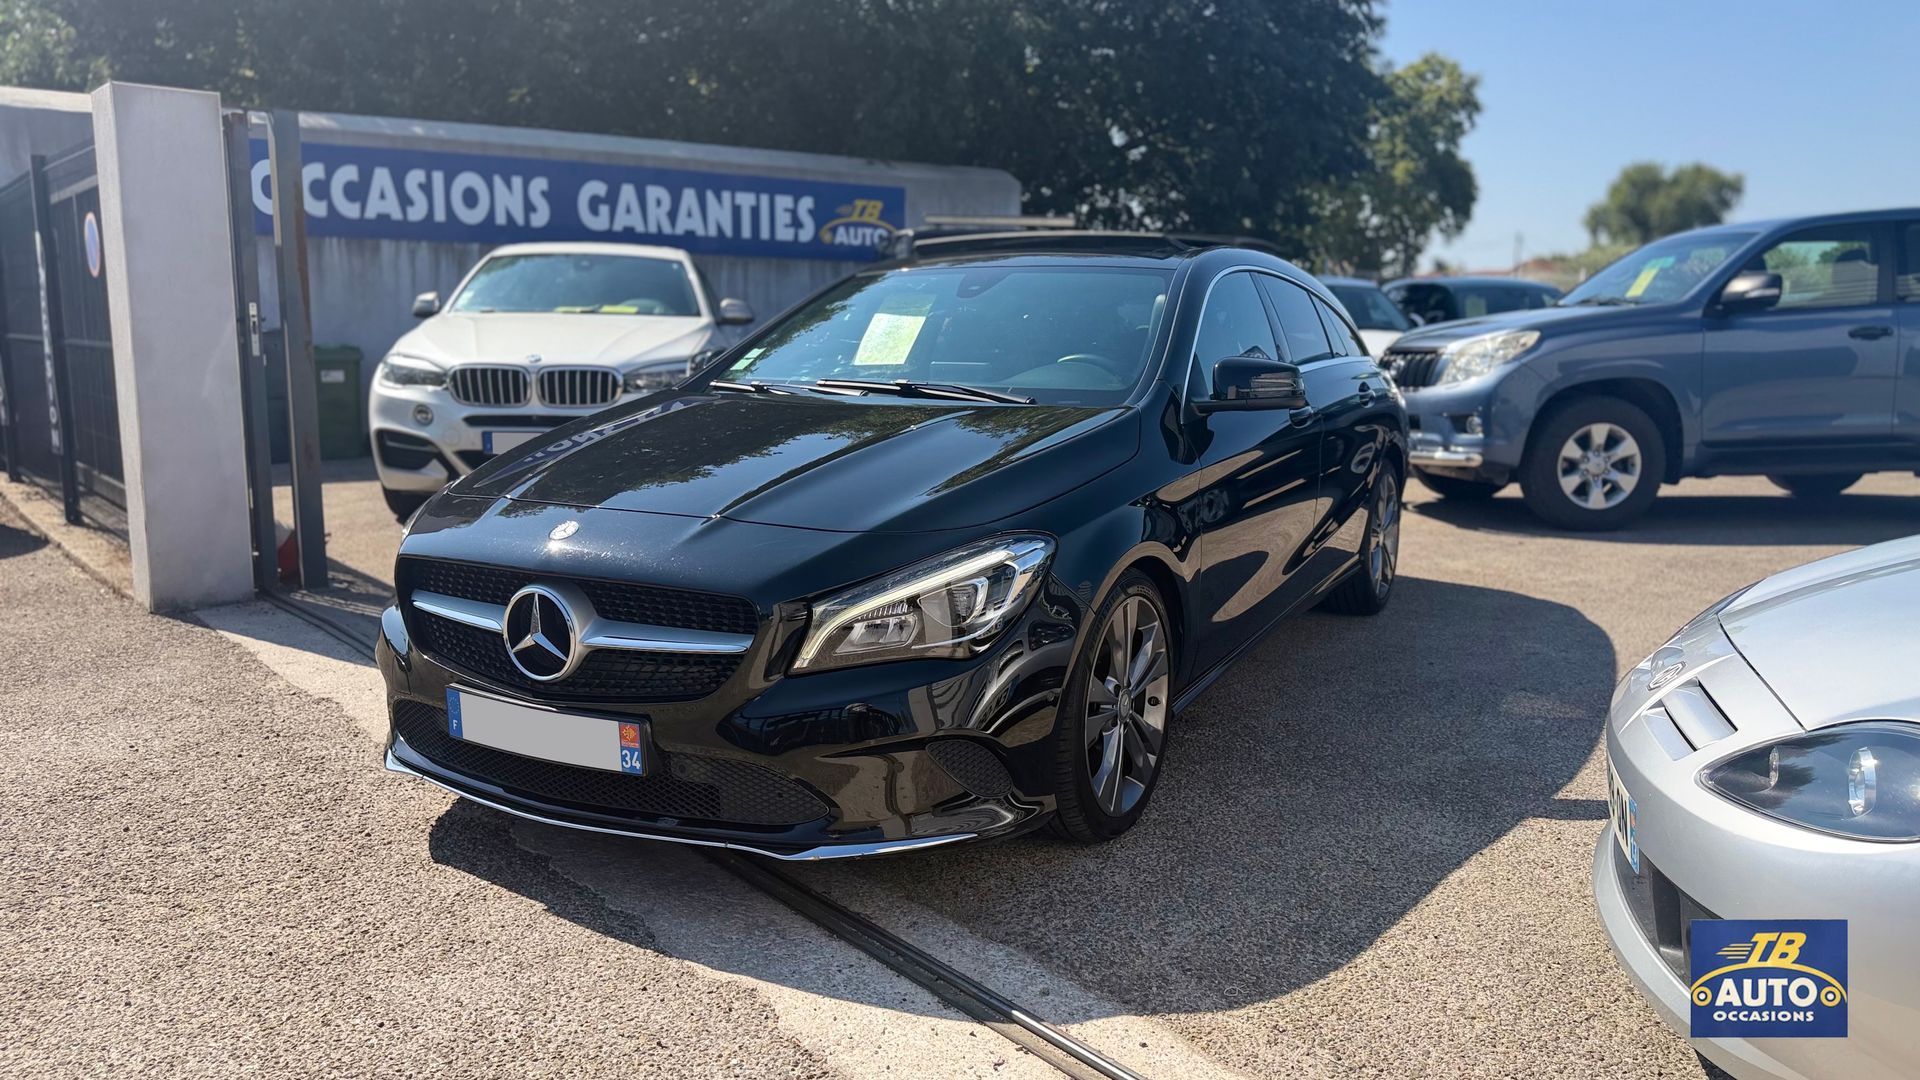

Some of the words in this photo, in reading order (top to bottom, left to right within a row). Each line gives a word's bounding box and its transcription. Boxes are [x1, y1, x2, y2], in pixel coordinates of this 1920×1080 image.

[251, 159, 550, 228] OCCASIONS
[577, 180, 816, 243] GARANTIES
[852, 200, 883, 220] TB
[453, 719, 458, 730] F
[622, 750, 641, 769] 34
